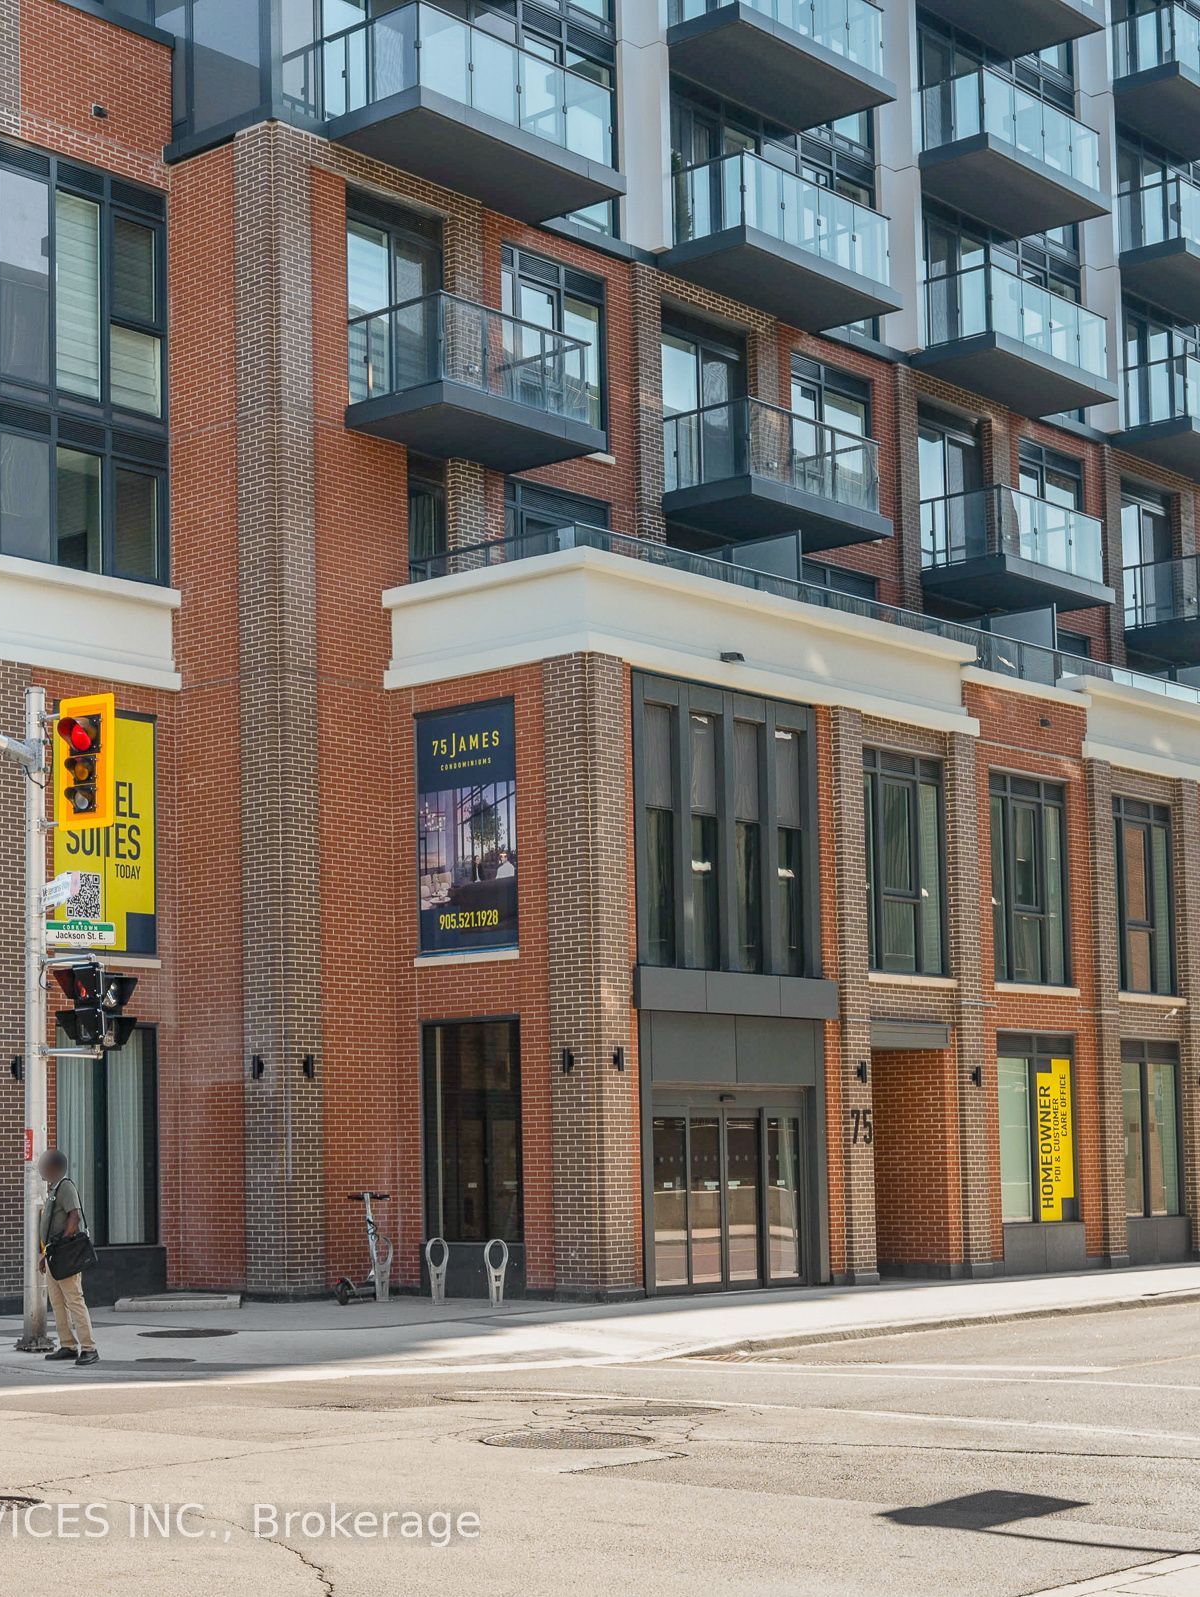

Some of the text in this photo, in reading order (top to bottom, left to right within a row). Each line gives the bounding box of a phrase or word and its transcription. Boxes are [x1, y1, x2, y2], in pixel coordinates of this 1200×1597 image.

[432, 730, 500, 758] 75 JAMES
[440, 757, 492, 771] CONDOMINIUMS
[115, 864, 141, 880] TODAY
[439, 909, 499, 930] 905.521.1928
[55, 931, 106, 941] Jackson St. E.
[850, 1109, 872, 1144] 75
[1052, 1098, 1060, 1151] CUSTOMER
[1038, 1085, 1054, 1209] HOMEOWNER
[1054, 1155, 1061, 1163] &
